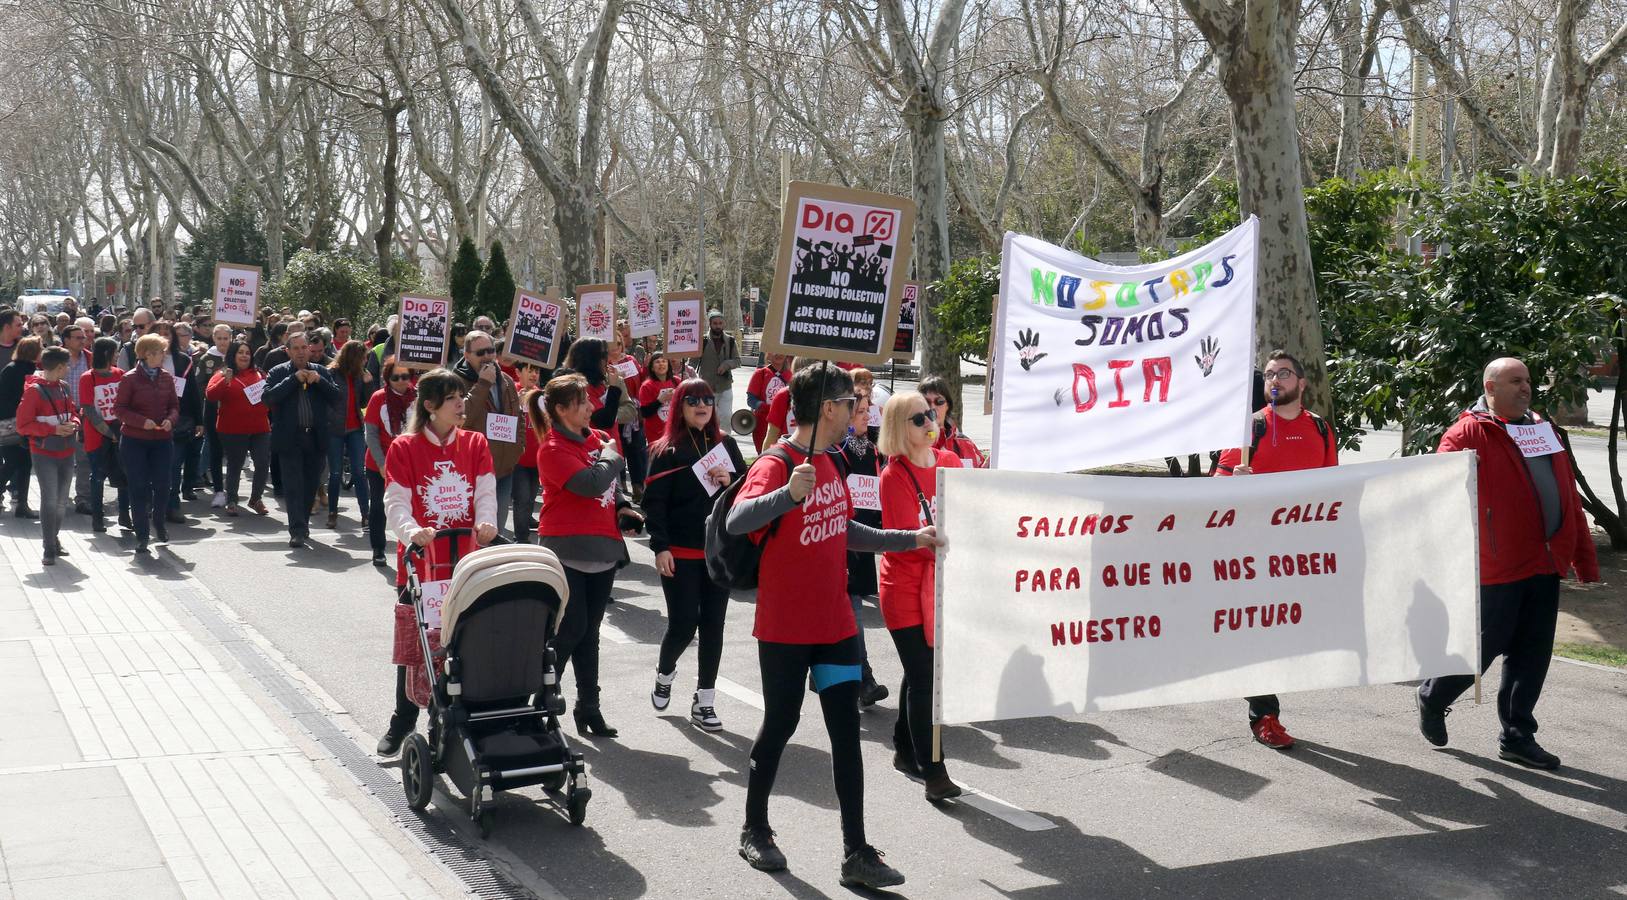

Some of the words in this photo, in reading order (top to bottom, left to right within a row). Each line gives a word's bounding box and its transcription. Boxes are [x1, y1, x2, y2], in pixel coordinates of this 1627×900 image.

[802, 204, 854, 233] Dia
[830, 270, 850, 287] NO
[1030, 254, 1237, 310] NOSOTROS
[792, 282, 803, 295] AL
[804, 284, 839, 299] DESPIDO
[841, 289, 885, 304] COLECTIVO
[795, 306, 814, 318] ¿DE
[816, 308, 835, 320] QUE
[836, 310, 875, 324] VIVIRÁN
[1074, 308, 1191, 346] SOMOS
[419, 328, 428, 336] NO
[530, 326, 539, 334] NO
[789, 321, 839, 337] NUESTROS
[841, 327, 876, 341] HIJOS?
[1072, 356, 1173, 413] DIA
[803, 511, 822, 525] POR
[1016, 513, 1134, 538] SALIMOS
[1157, 513, 1175, 532] A
[1205, 508, 1236, 528] LA
[1270, 501, 1343, 526] CALLE
[1015, 566, 1081, 592] PARA
[1101, 562, 1151, 587] QUE
[1162, 561, 1192, 585] NO
[1213, 555, 1256, 581] NOS
[1268, 552, 1337, 578] ROBEN
[1050, 614, 1161, 646] NUESTRO
[1213, 602, 1302, 633] FUTURO
